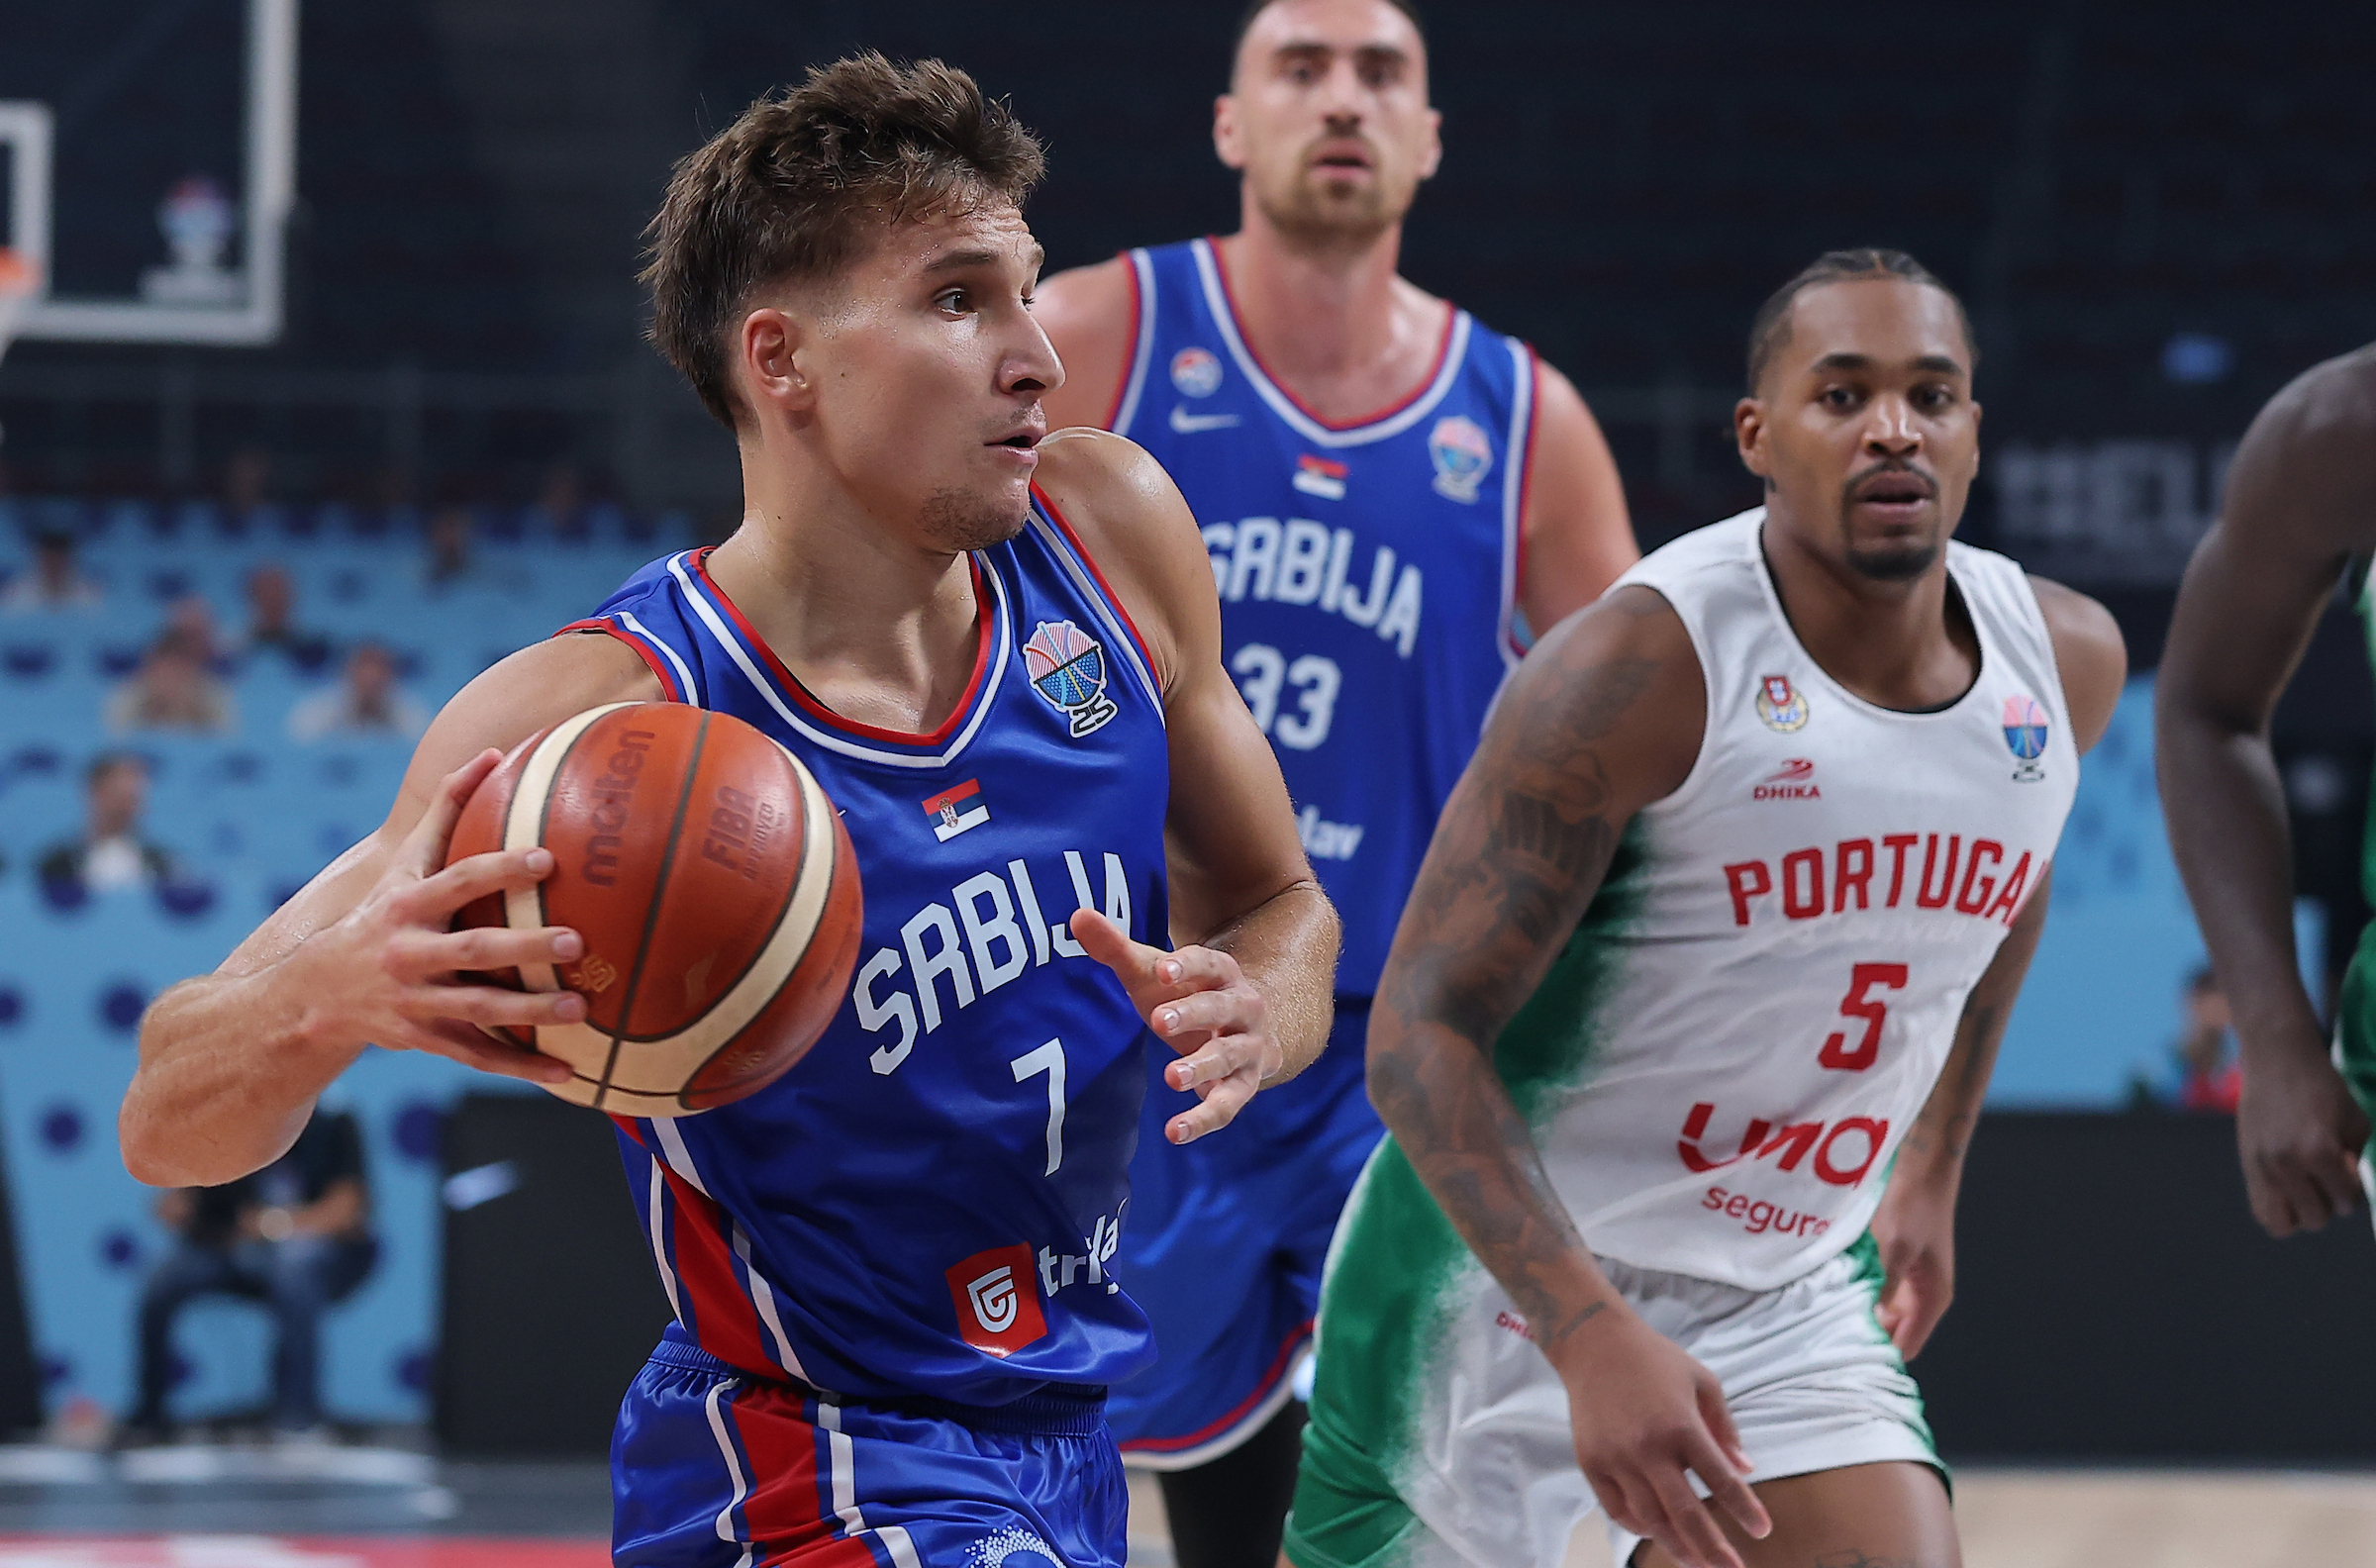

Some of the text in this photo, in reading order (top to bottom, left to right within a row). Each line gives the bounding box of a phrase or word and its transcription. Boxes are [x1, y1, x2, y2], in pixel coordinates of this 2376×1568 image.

[1072, 695, 1116, 735] 25
[1232, 641, 1343, 752] 33
[580, 730, 655, 887] molten
[700, 785, 754, 871] FIBA
[1294, 804, 1364, 861] lav
[1752, 785, 1821, 800] DHIKA
[852, 850, 1132, 1076] SRBIJA
[1818, 961, 1910, 1072] 5
[1010, 1037, 1066, 1178] 7
